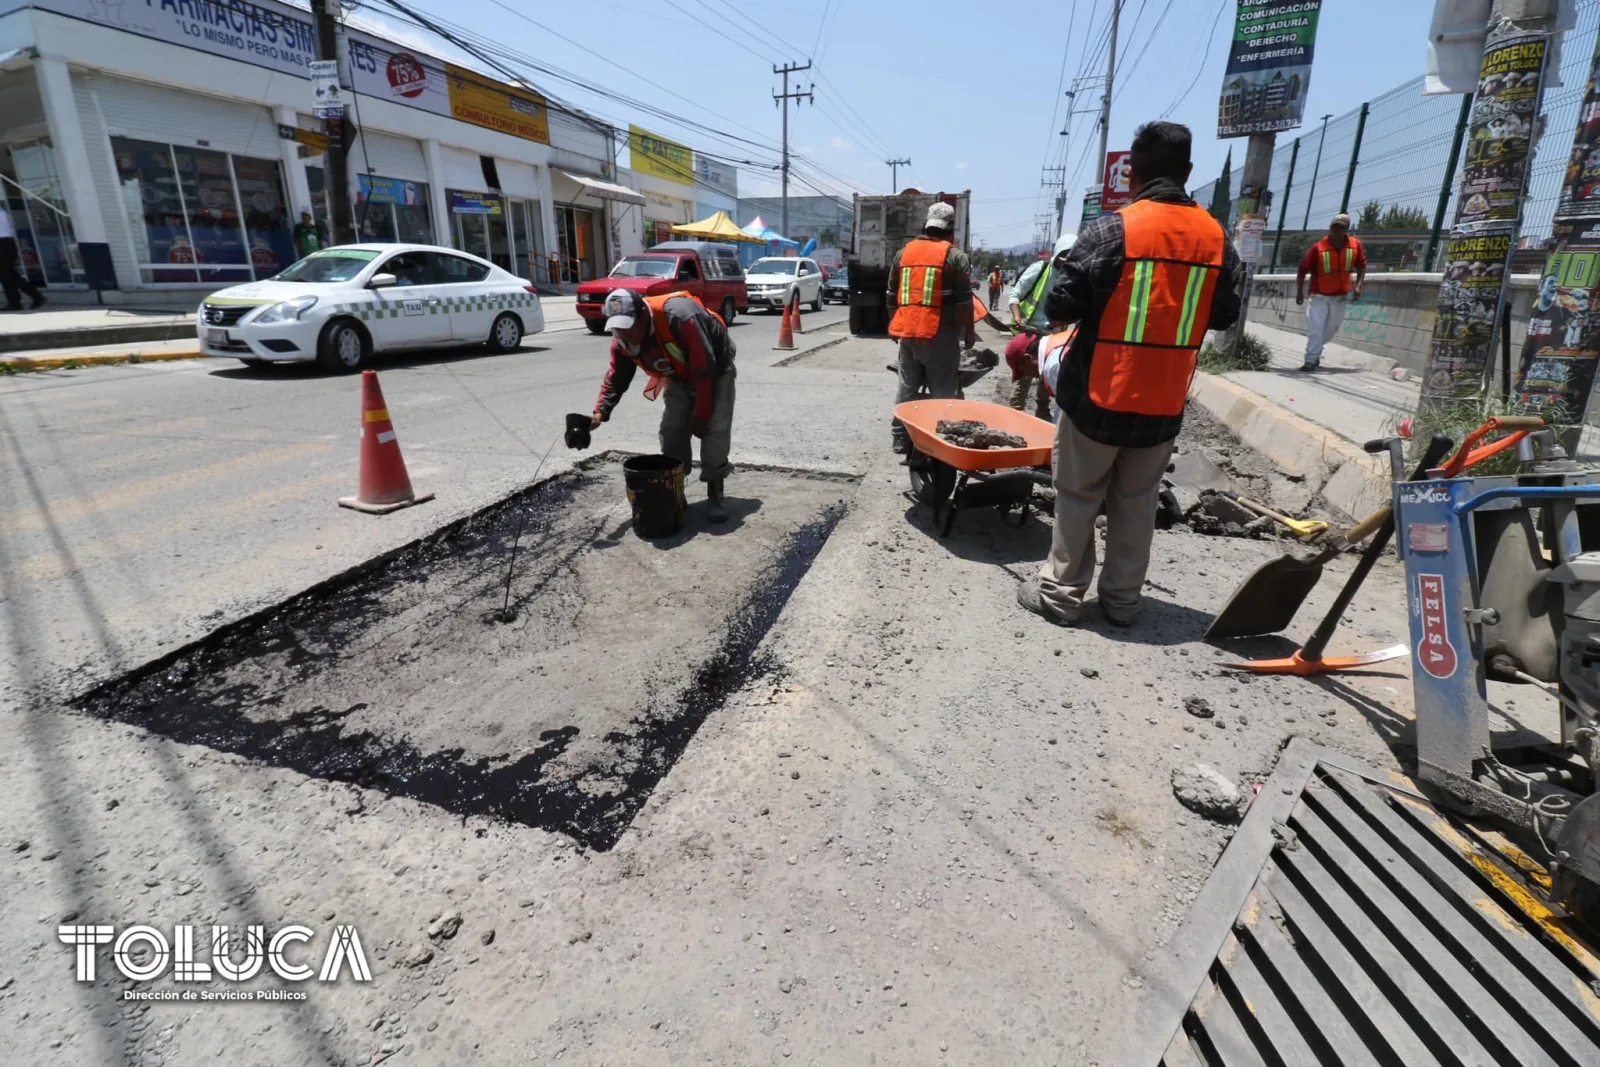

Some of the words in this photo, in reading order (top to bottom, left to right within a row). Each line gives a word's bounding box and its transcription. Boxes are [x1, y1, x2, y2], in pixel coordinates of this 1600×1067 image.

[1243, 18, 1309, 34] CONTADURÍA
[204, 28, 244, 50] MISMO
[247, 40, 278, 60] PERO
[280, 51, 303, 67] MAS
[1249, 33, 1297, 48] DERECHO
[454, 105, 517, 133] CONSULTORIO
[406, 303, 422, 312] TAXI
[1424, 580, 1444, 662] FELSA
